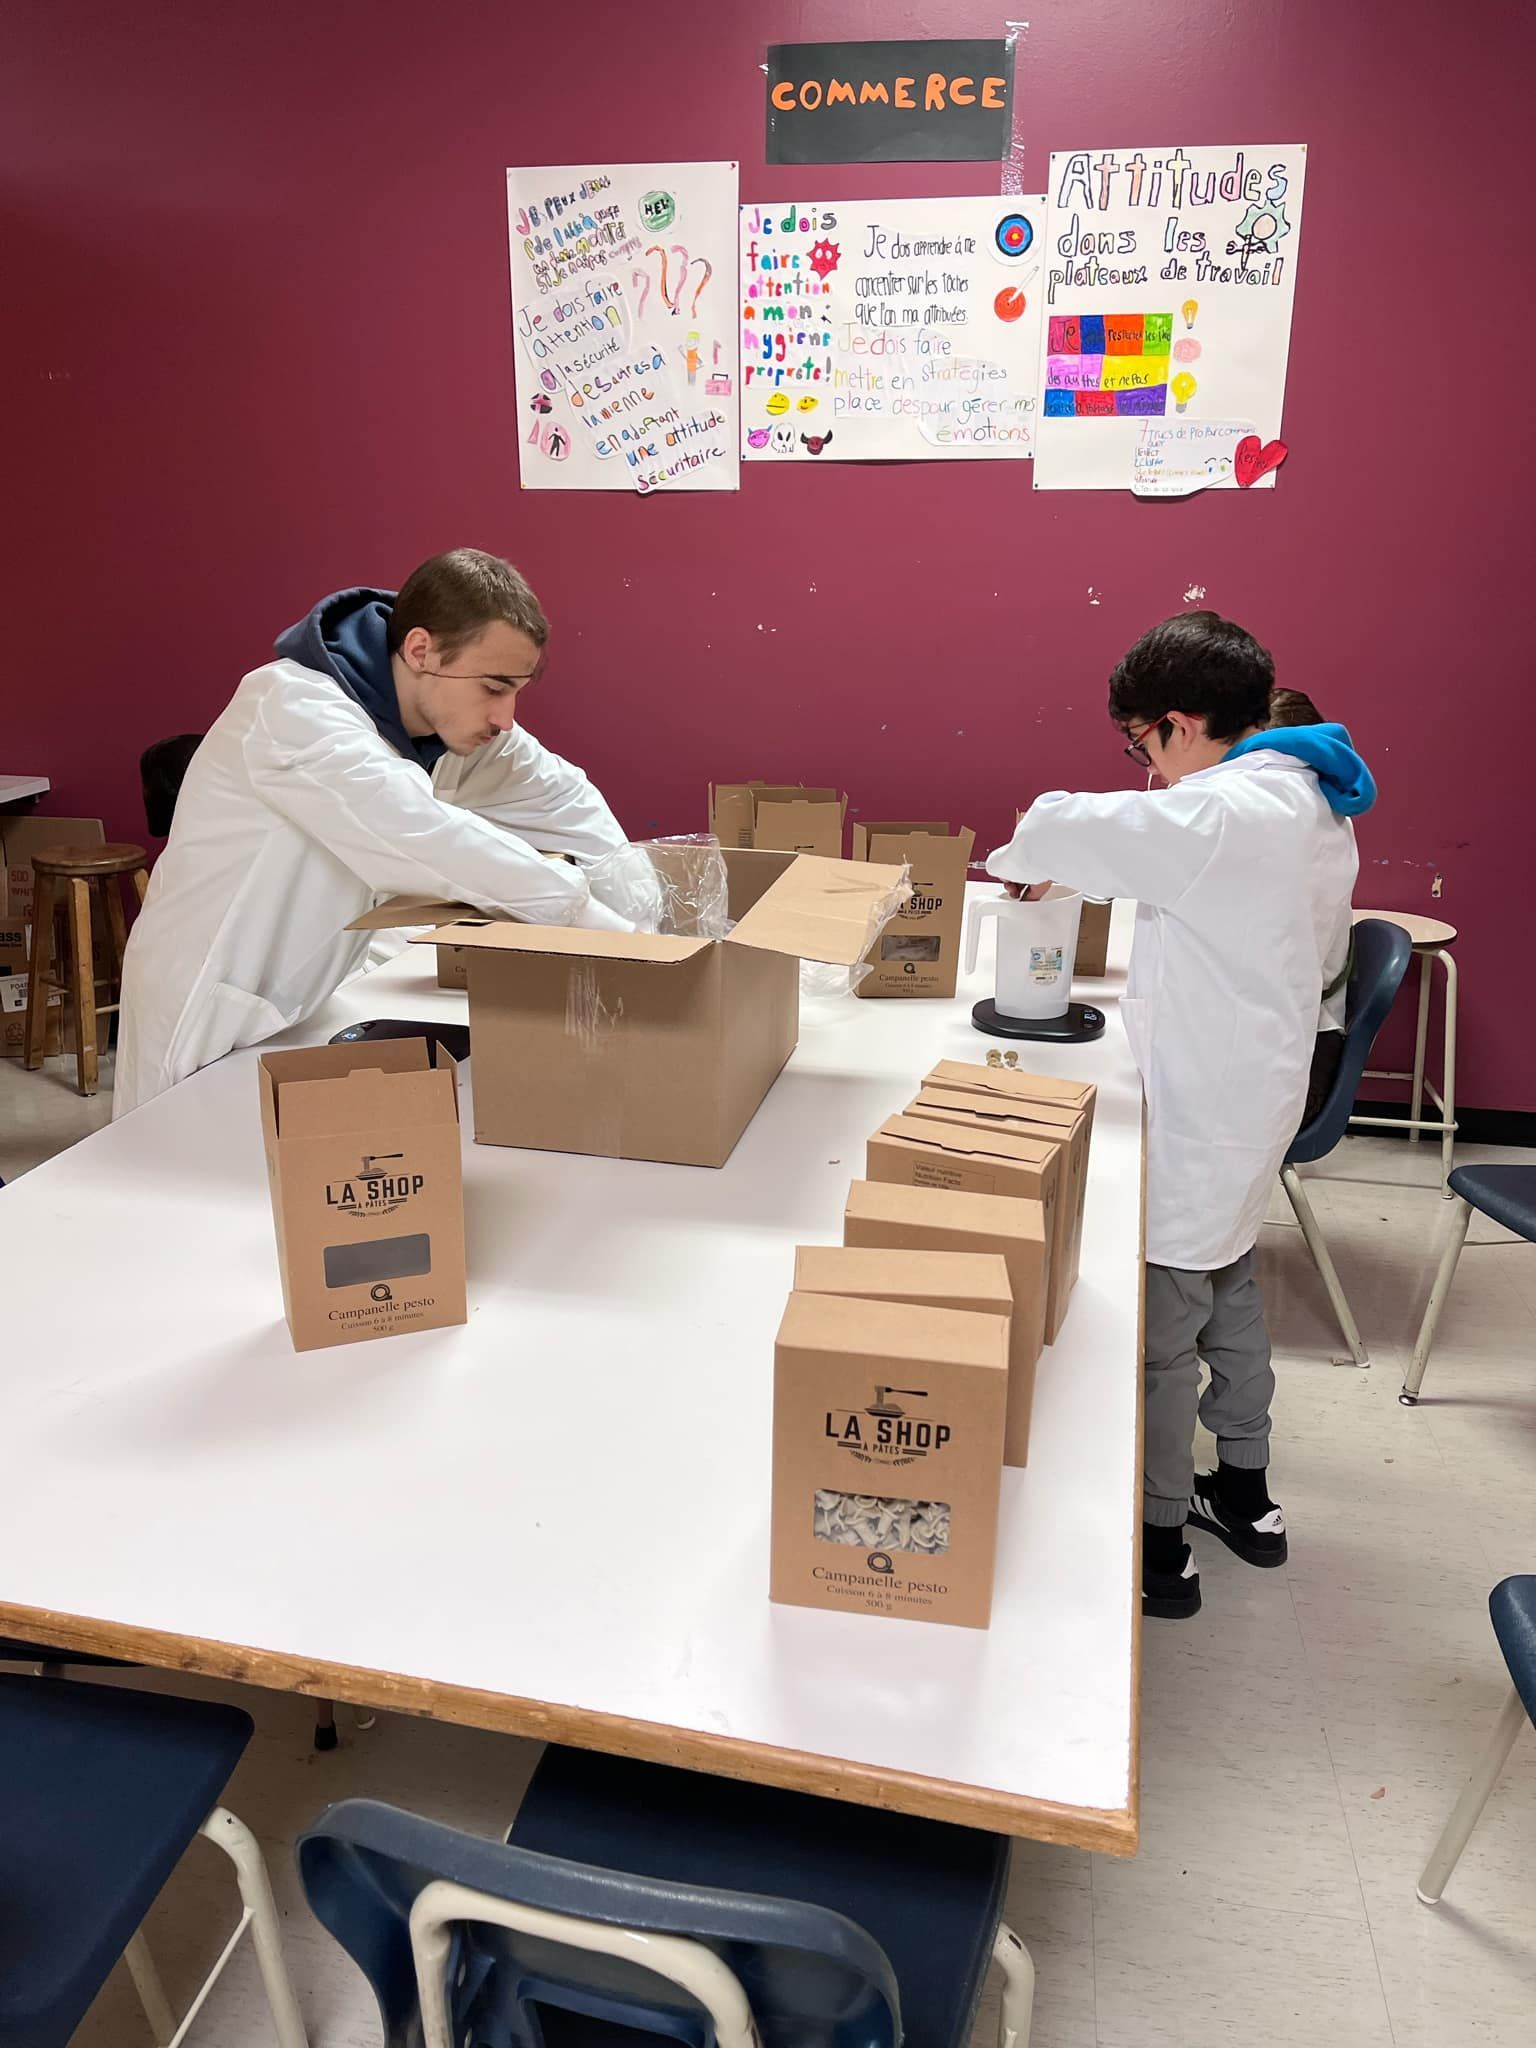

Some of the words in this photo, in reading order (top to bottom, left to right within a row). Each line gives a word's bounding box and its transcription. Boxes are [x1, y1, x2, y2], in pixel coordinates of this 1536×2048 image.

[771, 73, 1006, 111] COMMERCE
[1057, 148, 1288, 210] Attitudes
[748, 208, 773, 234] Je
[780, 205, 837, 232] dois
[864, 225, 887, 259] Je
[1057, 213, 1136, 257] dans
[1163, 217, 1206, 252] les
[746, 241, 801, 272] faire
[748, 272, 831, 298] attention
[907, 275, 924, 295] sur
[924, 269, 938, 296] les
[1048, 255, 1149, 304] plateaux
[1160, 258, 1187, 281] de
[1196, 250, 1284, 286] travail
[518, 304, 548, 337] Je
[552, 297, 585, 323] dois
[585, 280, 623, 308] faire
[763, 305, 812, 321] mon
[855, 303, 877, 326] que
[532, 305, 622, 358] attention
[838, 323, 867, 355] Je
[869, 329, 907, 355] dois
[914, 328, 951, 356] faire
[1051, 319, 1080, 353] Je
[573, 336, 621, 372] sécurité
[834, 366, 884, 391] mettre
[891, 377, 915, 391] en
[834, 391, 883, 416] place
[595, 433, 622, 456] en
[625, 441, 658, 467] une
[665, 410, 726, 448] attitude
[1138, 418, 1149, 442] 7
[910, 898, 943, 910] SHOP
[326, 1183, 355, 1205] LA
[367, 1175, 424, 1200] SHOP
[328, 1302, 400, 1320] Campanelle
[403, 1298, 435, 1312] pesto
[826, 1412, 861, 1441] LA
[877, 1419, 950, 1449] SHOP
[812, 1566, 902, 1589] Campanelle
[907, 1581, 948, 1595] pesto
[826, 1584, 865, 1598] Cuisson
[868, 1590, 874, 1598] 6
[894, 1594, 933, 1606] minutes
[865, 1600, 883, 1608] 500
